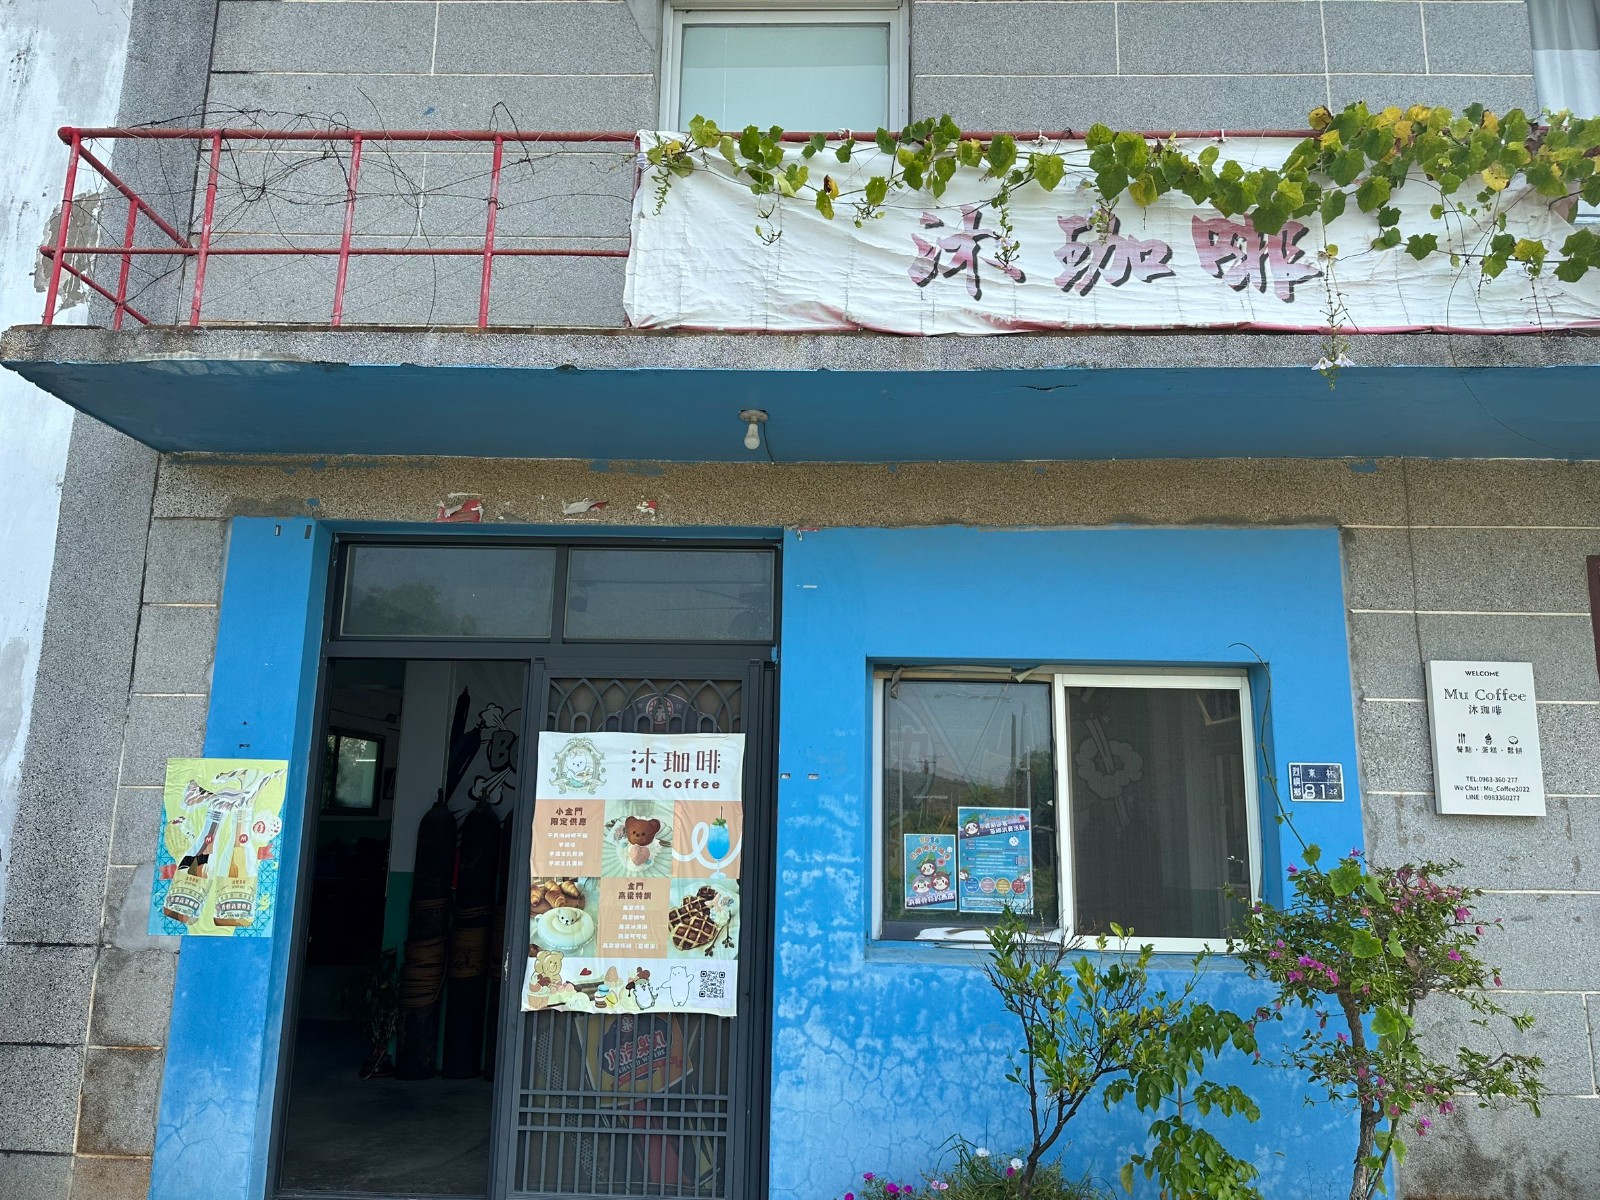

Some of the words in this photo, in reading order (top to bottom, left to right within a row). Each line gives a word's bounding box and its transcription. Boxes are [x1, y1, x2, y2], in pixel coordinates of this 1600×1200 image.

[1444, 688, 1469, 700] Mu
[1474, 688, 1527, 701] Coffee
[631, 747, 721, 775] 沐珈啡
[631, 778, 654, 789] Mu
[663, 778, 720, 790] Coffee
[1464, 784, 1479, 792] Chat
[556, 807, 583, 816] 小金門
[550, 817, 587, 826] 限定供應
[627, 882, 644, 890] 金門
